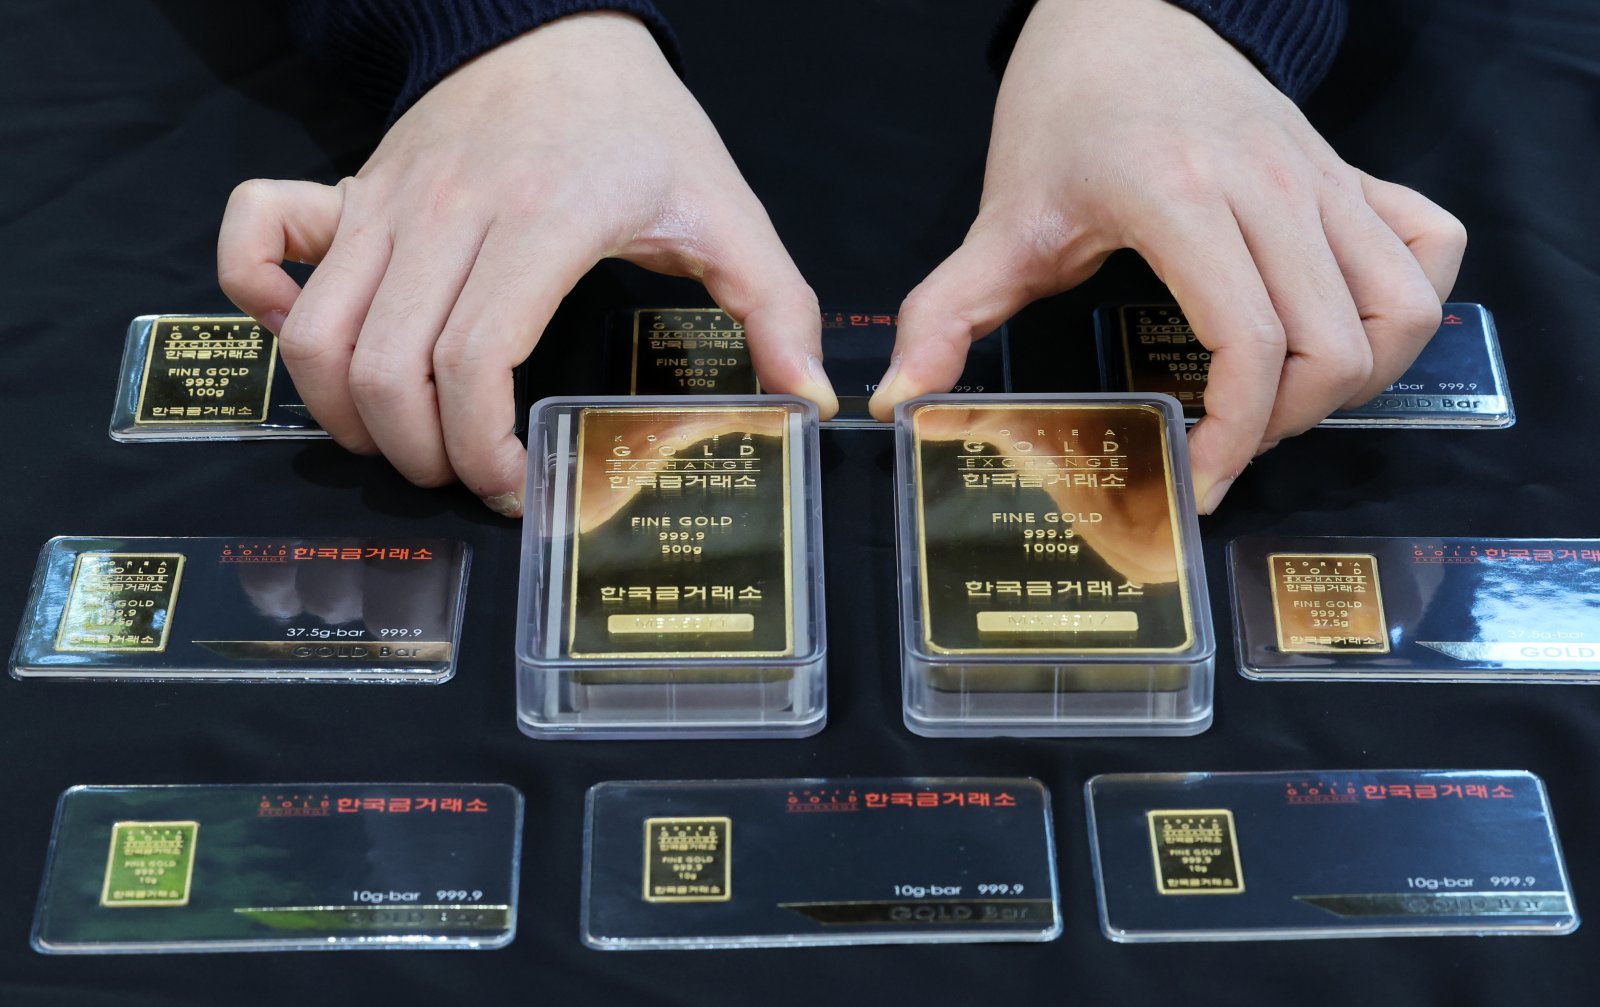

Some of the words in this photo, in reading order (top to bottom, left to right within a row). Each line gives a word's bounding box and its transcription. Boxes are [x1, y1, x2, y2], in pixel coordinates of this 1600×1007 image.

[653, 322, 743, 330] GOLD
[170, 332, 260, 340] GOLD
[168, 341, 257, 349] EXCHANGE
[166, 350, 258, 360] 한국금거래소
[1148, 353, 1181, 361] FINE
[1186, 352, 1211, 361] GO
[656, 358, 688, 366] FINE
[694, 358, 737, 366] GOLD
[168, 368, 200, 376] FINE
[206, 368, 249, 376] GOLD
[675, 368, 719, 377] 999.9
[185, 378, 230, 387] 999.9
[679, 379, 716, 388] 100g
[1438, 382, 1478, 391] 999.9
[188, 388, 225, 397] 100g
[954, 385, 985, 393] 99.9
[1442, 399, 1482, 409] Bar
[153, 407, 252, 416] 한국금거래소
[612, 445, 755, 457] GOLD
[963, 441, 1119, 453] GOLD
[613, 461, 753, 470] EXCHANGE
[966, 458, 1120, 468] EXCHANGE
[608, 474, 757, 489] 한국금거래소
[962, 473, 1126, 488] 한국금거래소
[631, 516, 671, 527] FINE
[679, 516, 733, 527] GOLD
[992, 512, 1036, 523] FINE
[1044, 512, 1103, 523] GOLD
[659, 532, 705, 541] 999.9
[1023, 529, 1074, 539] 999.9
[661, 545, 702, 555] 500g
[1023, 543, 1079, 554] 1000g
[293, 548, 433, 560] 한국금거래소
[1285, 567, 1362, 575] GOLD
[965, 581, 1144, 596] 한국금거래소
[1286, 584, 1366, 592] 한국금거래소
[600, 586, 763, 601] 한국금거래소
[1293, 600, 1321, 608] FINE
[1325, 600, 1362, 608] GOLD
[1310, 610, 1348, 618] 999.9
[1313, 619, 1349, 627] 37.5g
[286, 628, 366, 639] 37.5g-bar
[380, 628, 424, 638] 999.9
[1290, 635, 1377, 645] 한국금거래소
[291, 646, 369, 658] GOLD
[378, 646, 421, 658] Bar
[1520, 646, 1596, 658] GOLD
[1363, 784, 1515, 799] 한국금거래소
[864, 793, 1017, 807] 한국금거래소
[337, 798, 489, 813] 한국금거래소
[1407, 876, 1475, 890] 10g-bar
[1490, 876, 1537, 888] 999.9
[894, 884, 963, 897] 10g-bar
[977, 884, 1025, 895] 999.9
[352, 890, 421, 902] 10g-bar
[436, 890, 483, 901] 999.9
